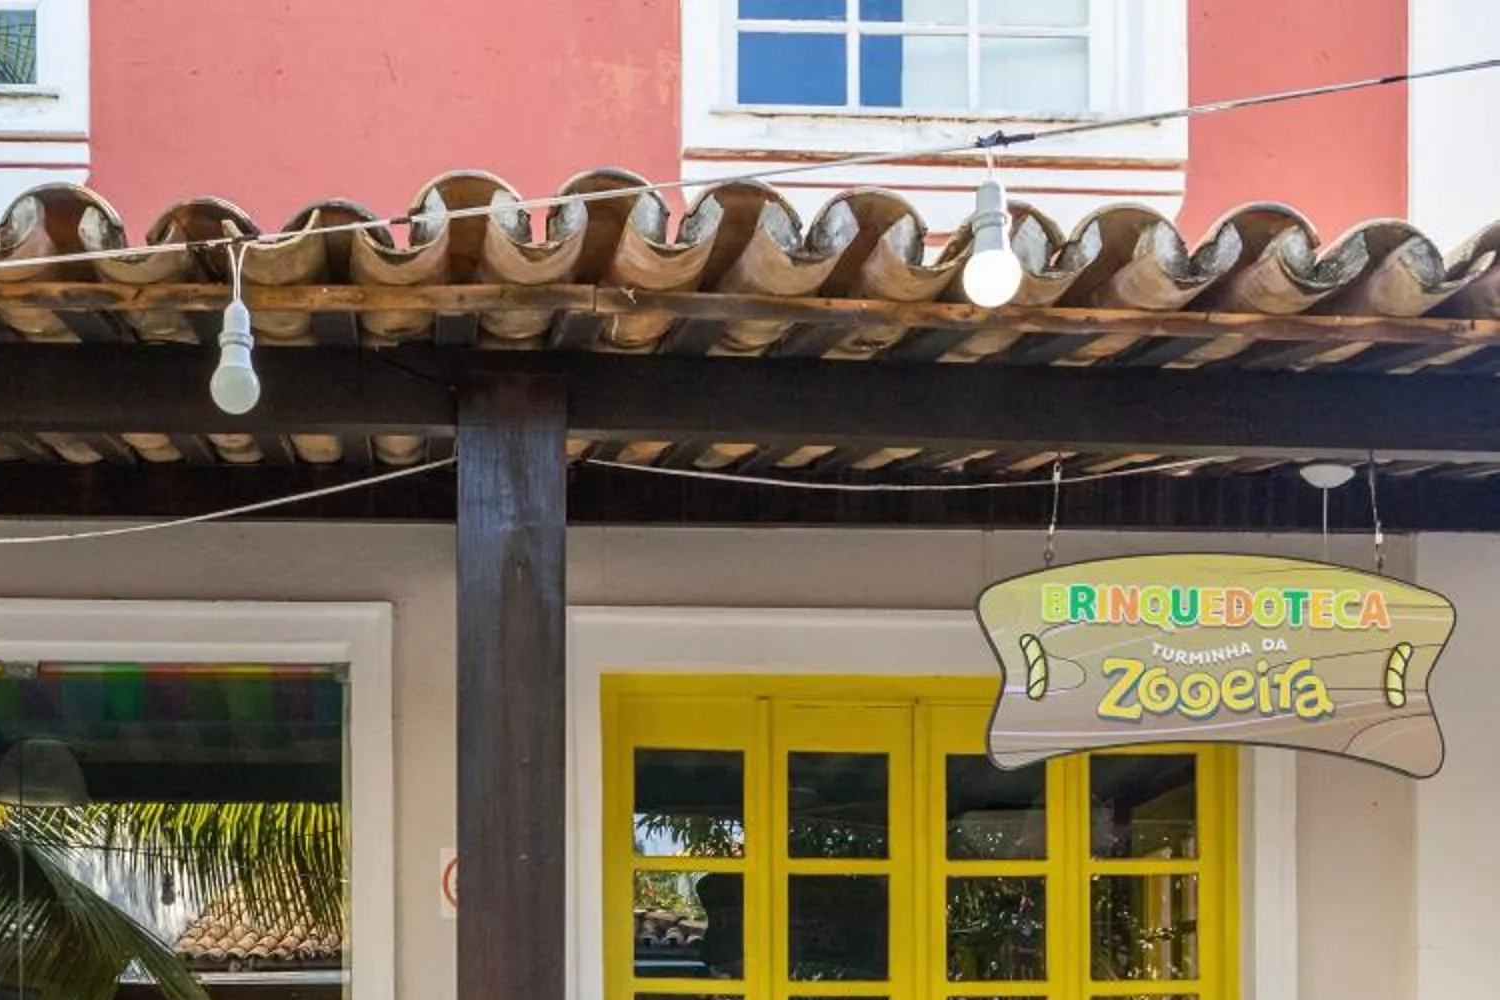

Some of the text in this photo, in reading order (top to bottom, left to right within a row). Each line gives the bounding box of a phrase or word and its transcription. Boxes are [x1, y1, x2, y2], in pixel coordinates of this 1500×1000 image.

[1042, 584, 1390, 631] BRINQUEDOTECA
[1151, 638, 1288, 666] TURMINHA DA
[1098, 658, 1335, 721] Zooeira
